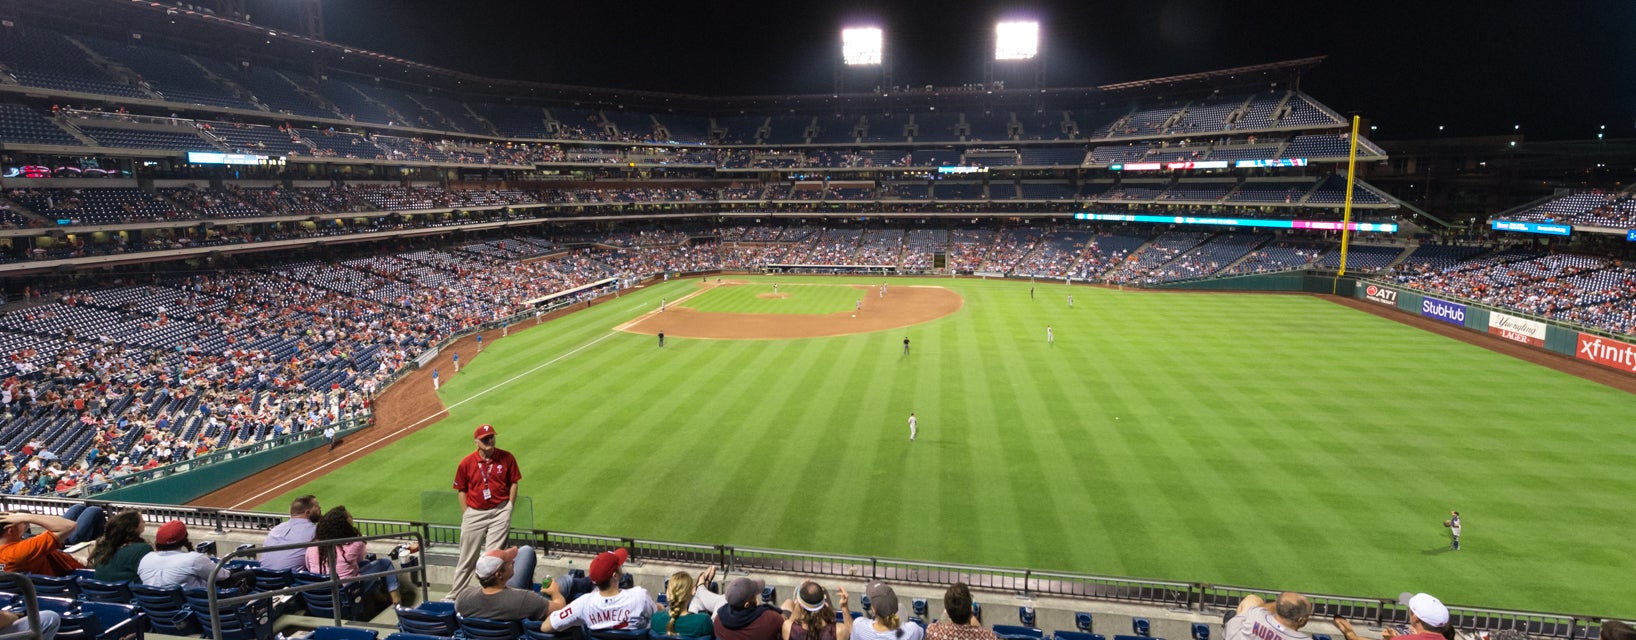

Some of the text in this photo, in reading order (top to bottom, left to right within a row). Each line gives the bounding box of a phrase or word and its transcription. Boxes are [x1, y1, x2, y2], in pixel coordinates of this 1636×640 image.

[1375, 288, 1397, 301] ATI
[1422, 300, 1465, 322] StubHub
[1495, 314, 1537, 335] Yuengling
[1502, 330, 1528, 343] LAGER
[588, 608, 631, 625] HAMELS
